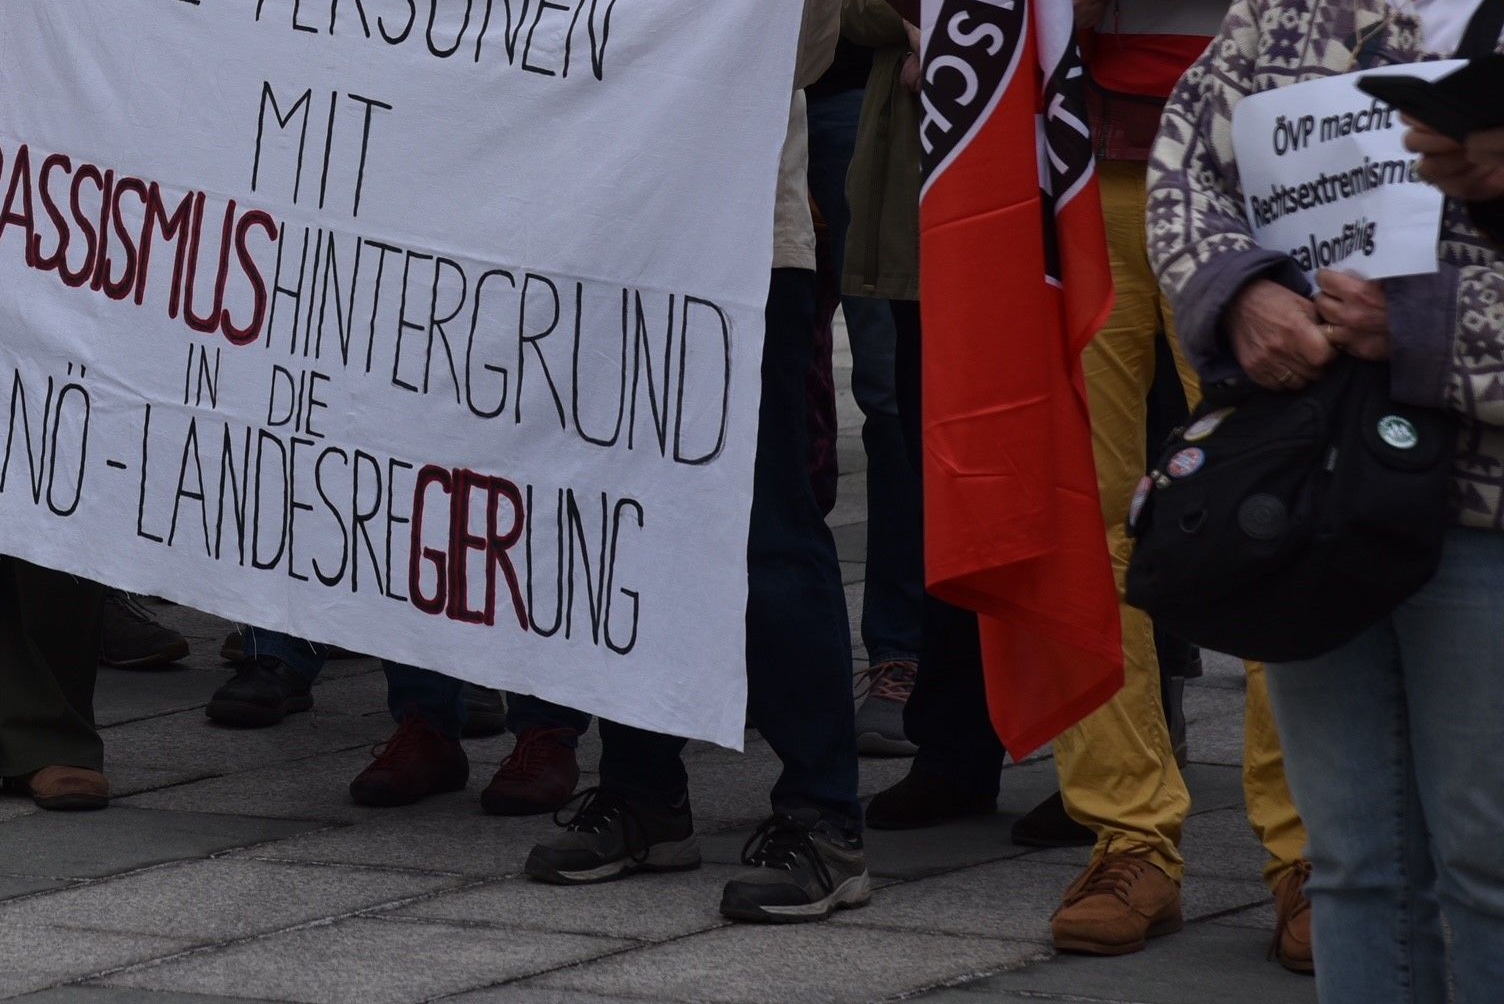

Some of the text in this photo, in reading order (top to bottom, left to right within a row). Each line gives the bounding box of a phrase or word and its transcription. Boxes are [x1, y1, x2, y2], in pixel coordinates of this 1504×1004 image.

[251, 81, 392, 217] MIT
[1273, 98, 1393, 156] ÖVP macht
[185, 343, 329, 438] IN DIE
